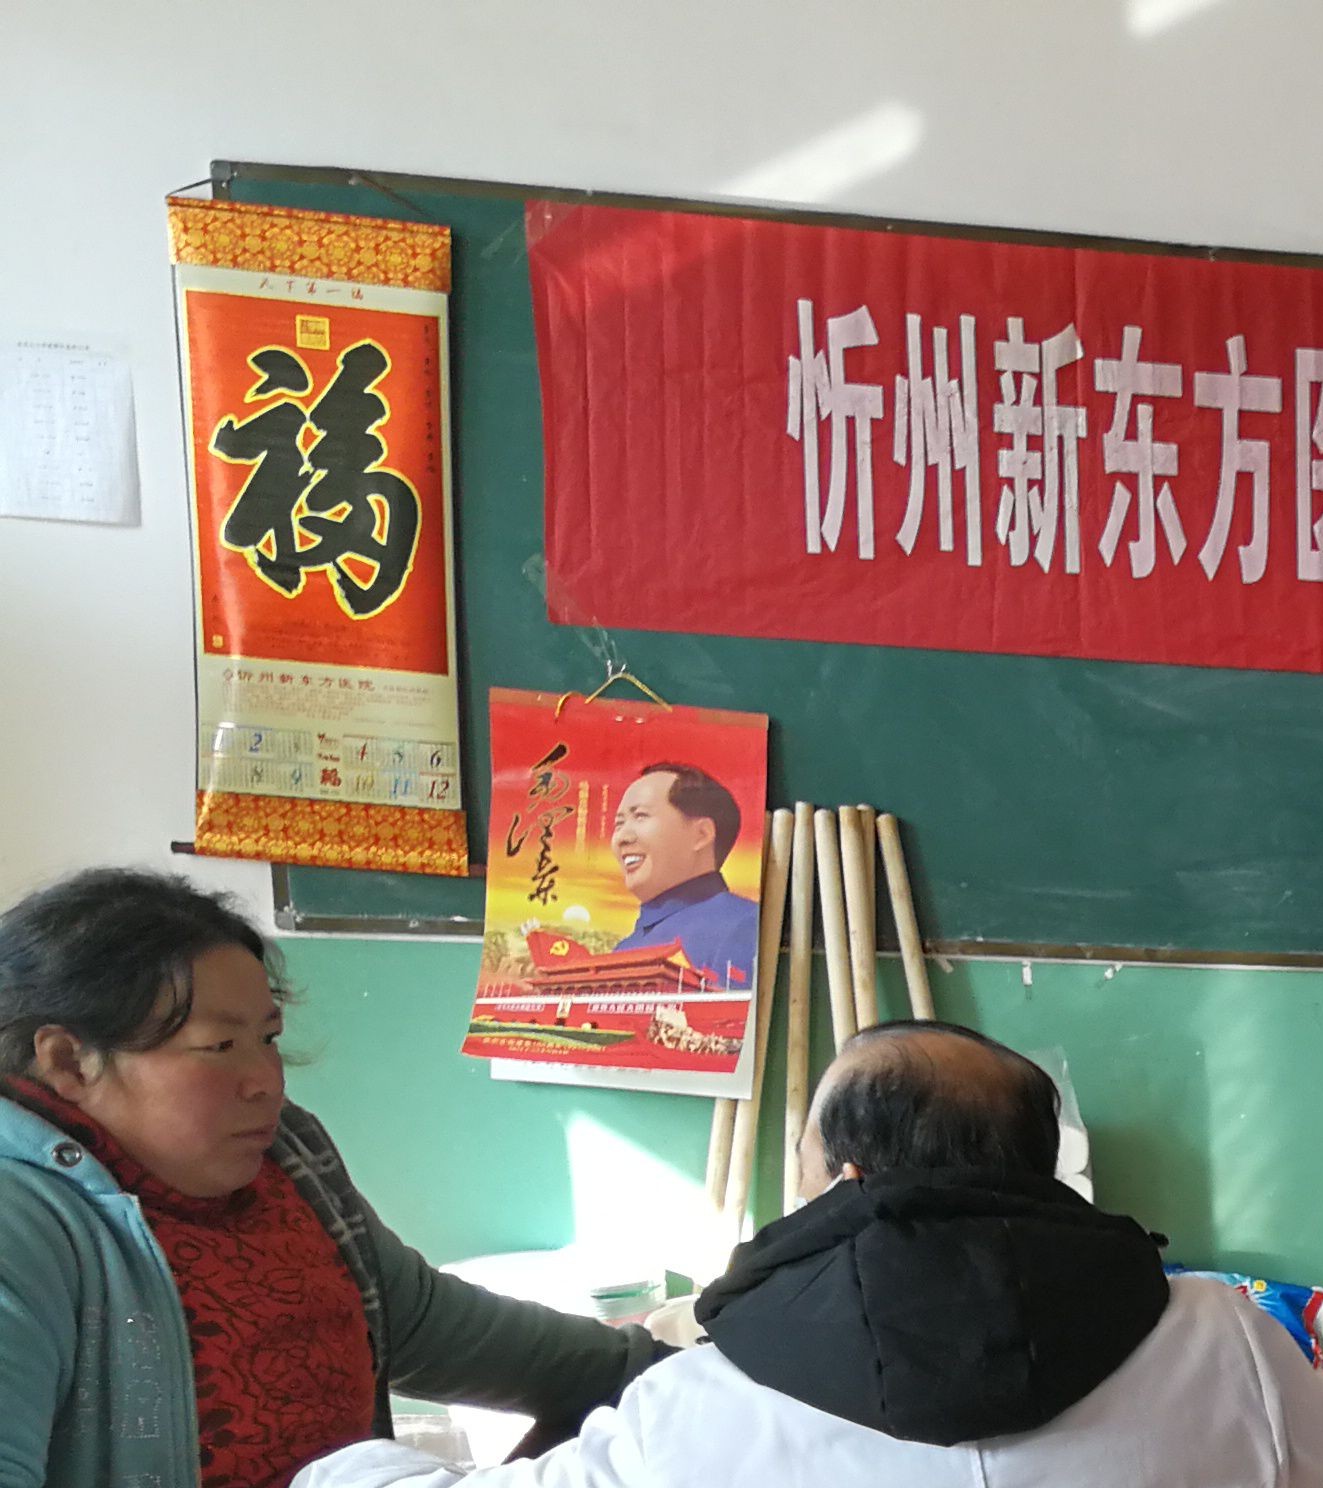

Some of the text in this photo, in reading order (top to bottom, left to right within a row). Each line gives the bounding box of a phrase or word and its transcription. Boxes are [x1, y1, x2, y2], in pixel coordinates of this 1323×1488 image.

[208, 336, 422, 620] 福
[237, 668, 376, 692] 忻州新东方医院
[249, 732, 264, 753] 2
[429, 749, 443, 769] 6
[427, 778, 451, 801] 12
